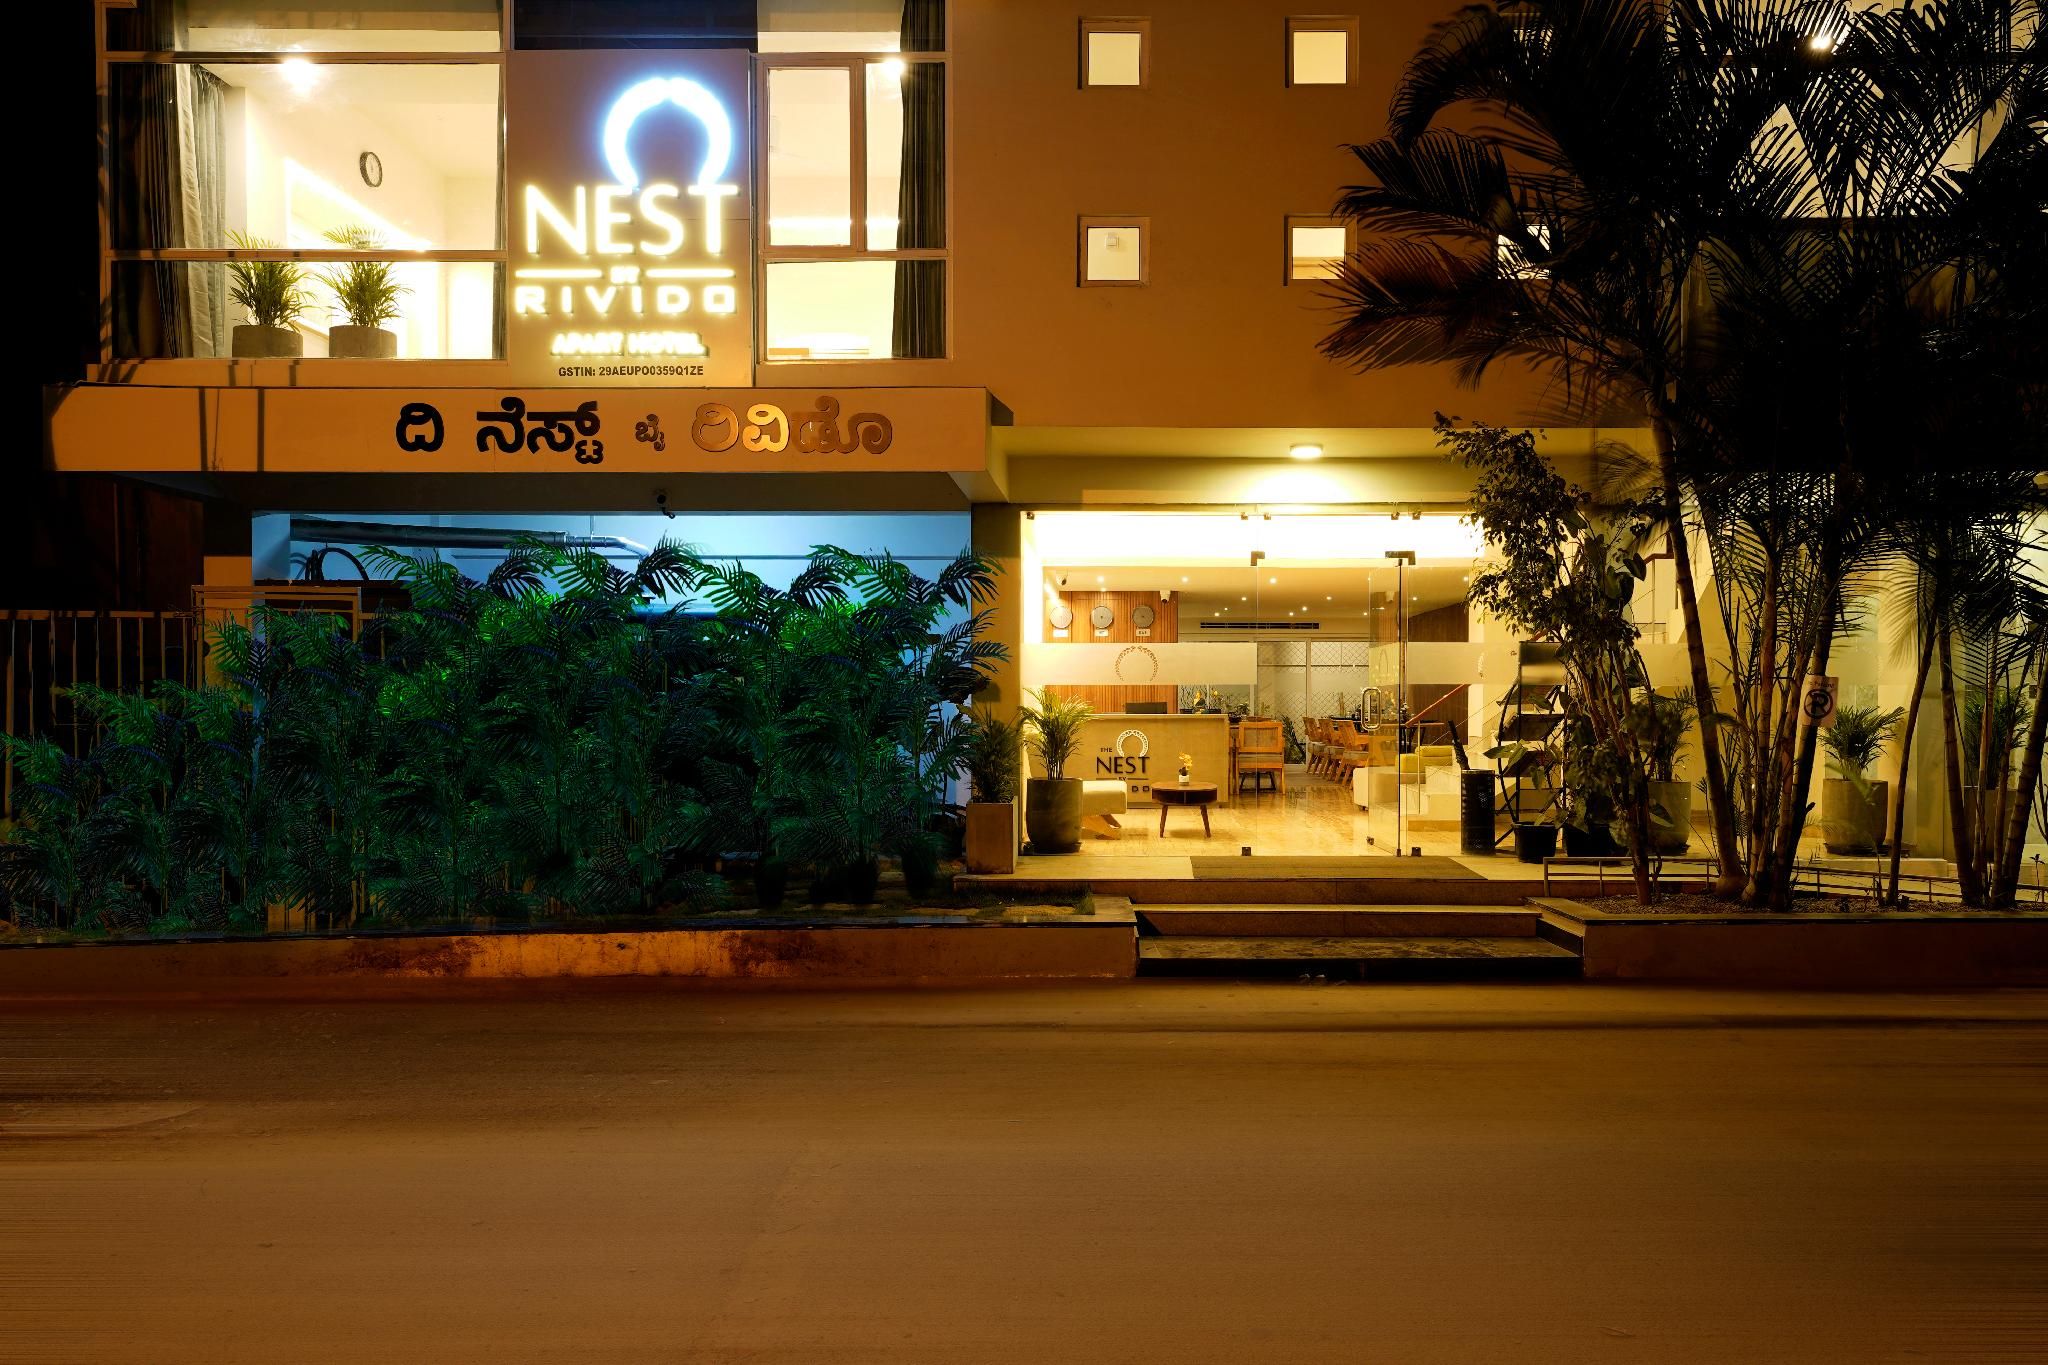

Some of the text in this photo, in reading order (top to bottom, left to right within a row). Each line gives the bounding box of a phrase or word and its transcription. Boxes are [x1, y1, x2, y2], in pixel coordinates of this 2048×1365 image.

[525, 184, 738, 256] NEST
[514, 285, 736, 314] RIVIDO
[558, 366, 596, 377] GSTIN:
[396, 402, 445, 452] ದಿ
[1096, 756, 1150, 774] NEST
